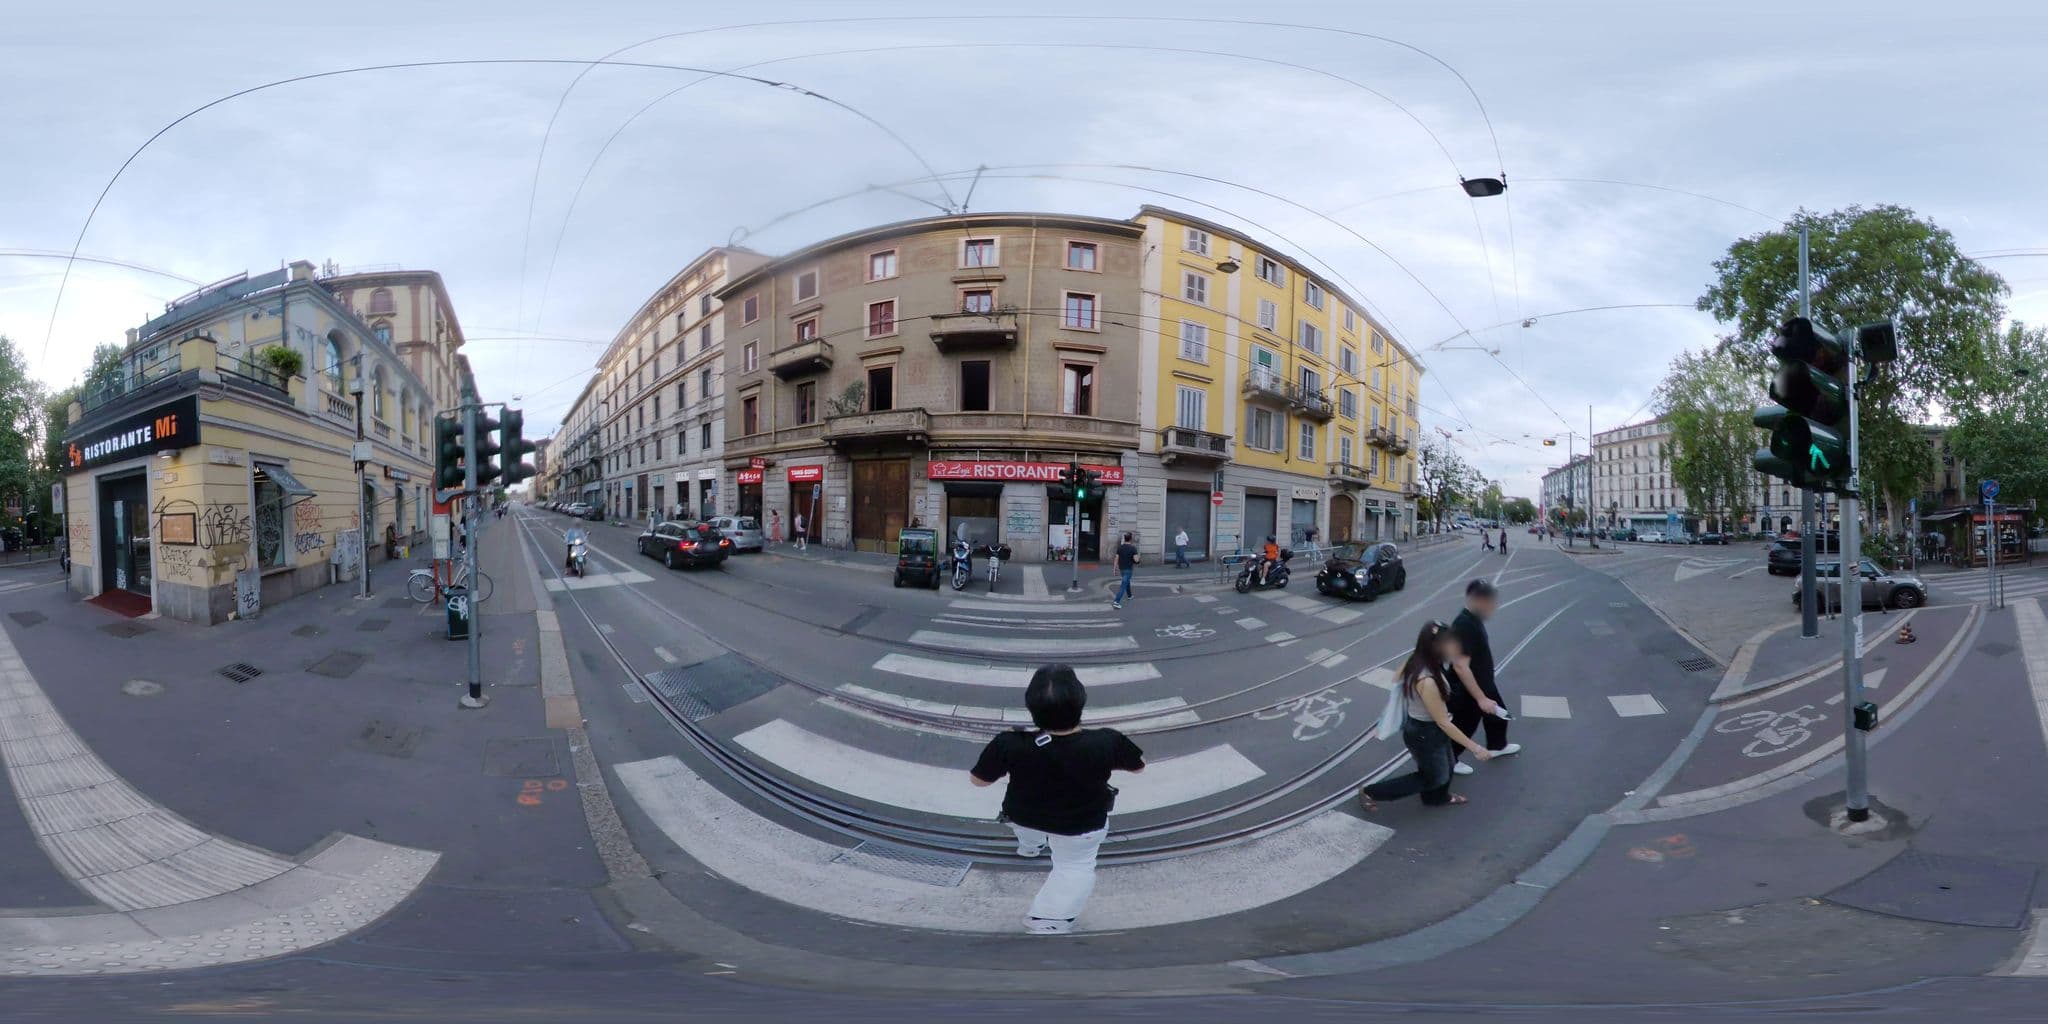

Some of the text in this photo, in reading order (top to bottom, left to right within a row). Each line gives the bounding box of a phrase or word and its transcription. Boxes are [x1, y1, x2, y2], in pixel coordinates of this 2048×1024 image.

[84, 414, 177, 460] RISTORANTE Mi
[974, 464, 1066, 480] RISTORANTE
